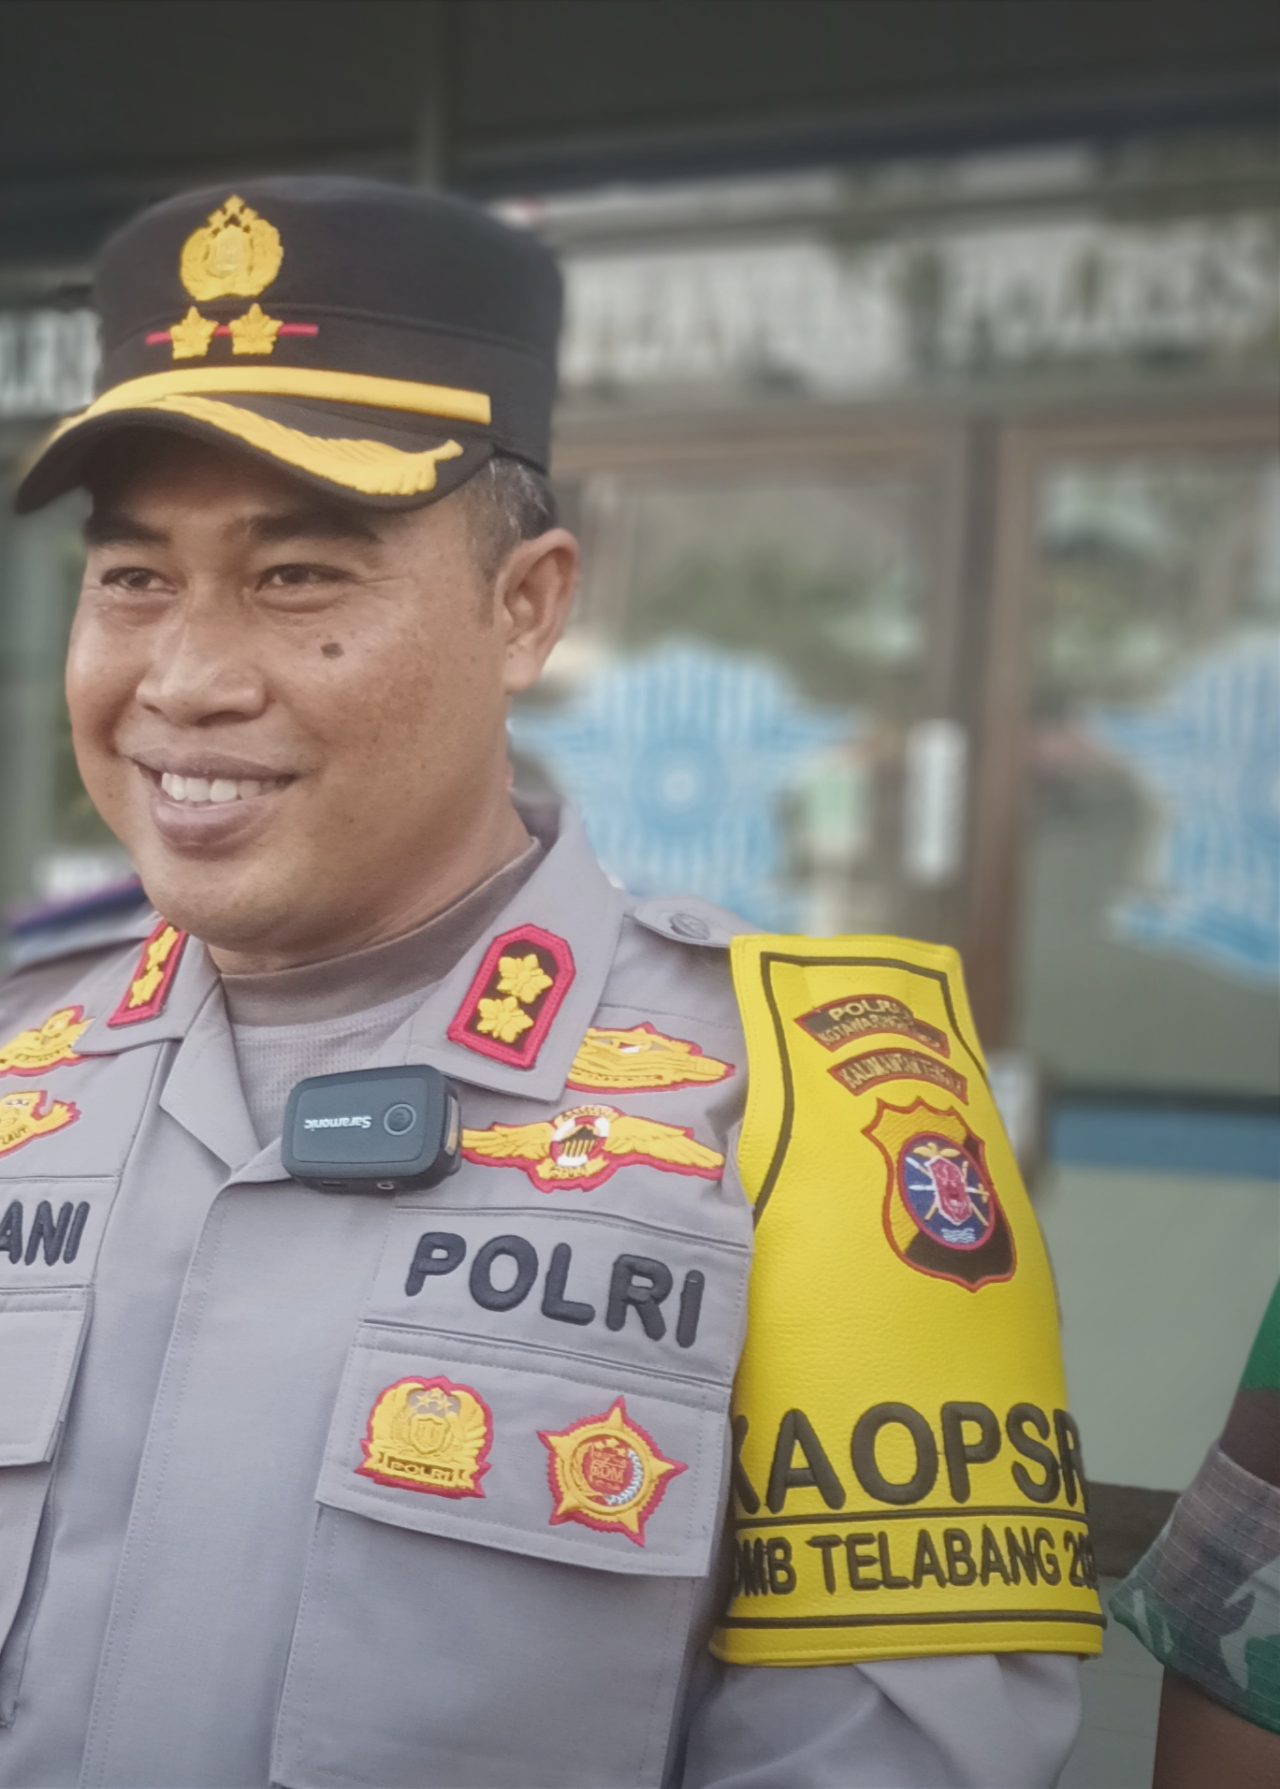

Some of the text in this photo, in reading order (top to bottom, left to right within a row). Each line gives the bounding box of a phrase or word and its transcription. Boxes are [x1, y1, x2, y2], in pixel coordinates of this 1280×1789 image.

[303, 1115, 373, 1132] Saramonic
[405, 1231, 706, 1348] POLRI
[390, 1459, 456, 1482] POLRI
[733, 1535, 797, 1598] MB
[805, 1523, 1062, 1596] TELABANG
